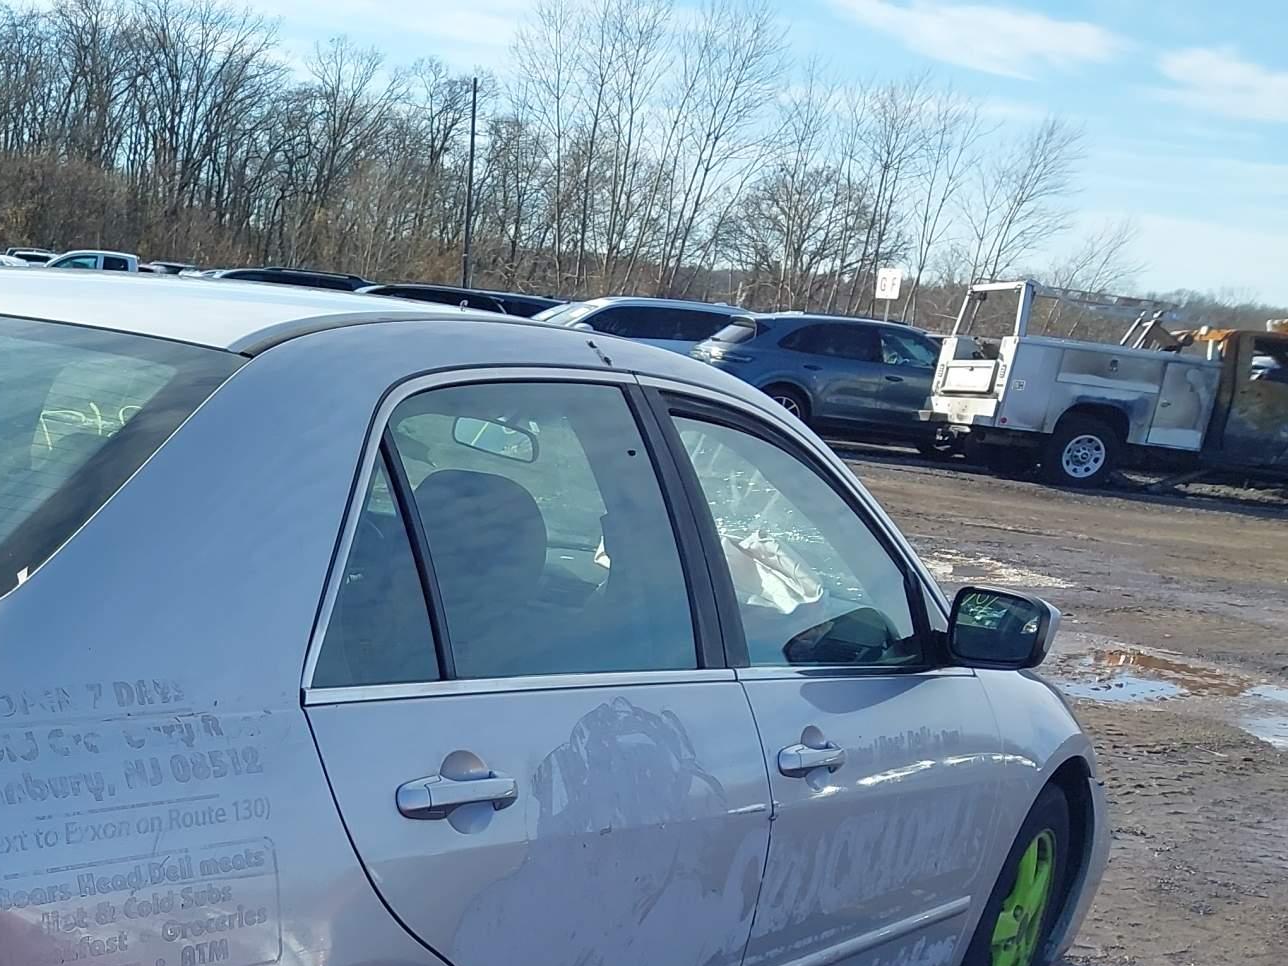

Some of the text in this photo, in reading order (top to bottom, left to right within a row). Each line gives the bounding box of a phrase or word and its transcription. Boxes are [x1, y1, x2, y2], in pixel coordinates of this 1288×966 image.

[170, 746, 263, 783] 08512
[35, 829, 58, 849] to
[136, 815, 162, 835] on
[168, 806, 226, 830] Route
[233, 796, 271, 822] 130)
[149, 854, 194, 885] Deli
[200, 848, 265, 876] meats
[123, 889, 174, 919] Cold
[180, 882, 232, 910] Subs
[162, 903, 268, 942] Groceries
